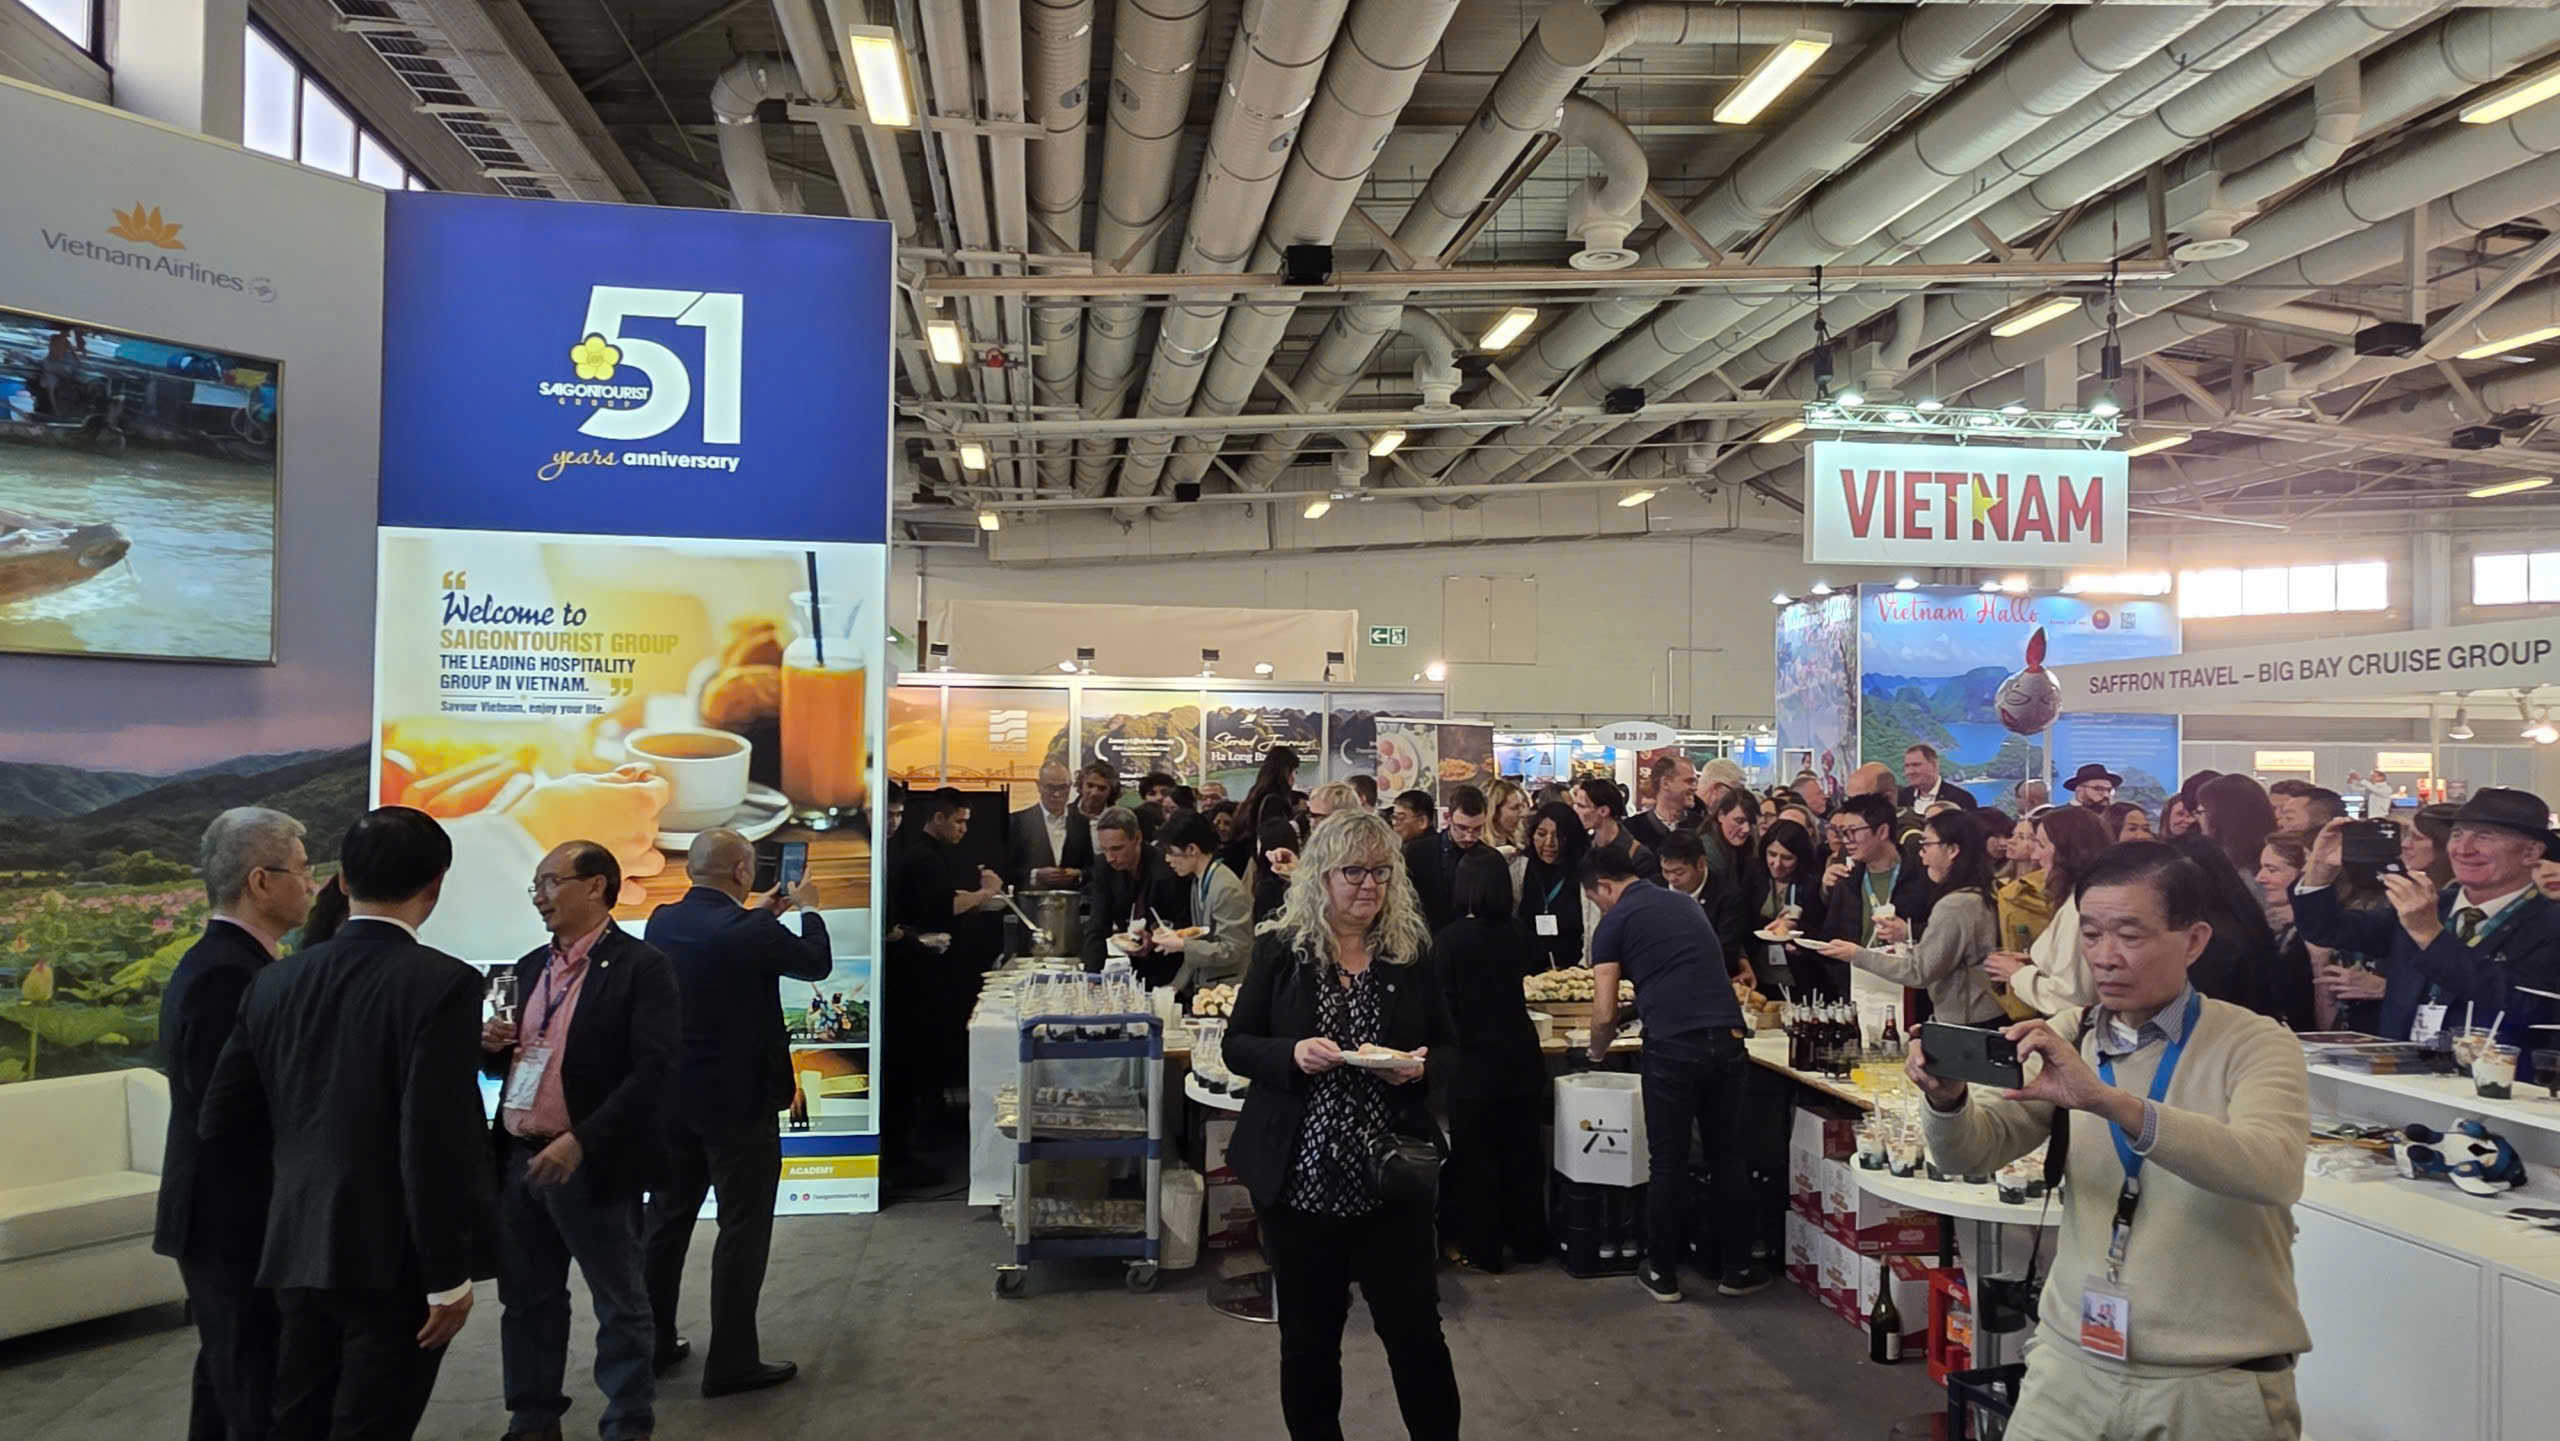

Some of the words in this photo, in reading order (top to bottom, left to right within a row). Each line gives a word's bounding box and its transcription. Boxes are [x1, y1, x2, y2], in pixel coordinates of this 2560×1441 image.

[41, 228, 151, 271] Vietnam
[153, 256, 243, 292] Airlines
[577, 285, 743, 444] 51
[539, 382, 650, 400] SAIGONTOURIST
[538, 449, 619, 481] years
[623, 451, 740, 472] anniversary
[1839, 468, 2103, 544] VIETNAM
[442, 591, 554, 626] Welcome
[563, 602, 587, 626] to
[1872, 592, 1968, 623] Vietnam
[1976, 593, 2039, 624] Hallo
[440, 629, 604, 653] SAIGONTOURIST
[611, 633, 679, 655] GROUP
[440, 654, 468, 669] THE
[471, 655, 536, 672] LEADING
[540, 656, 636, 673] HOSPITALITY
[2089, 671, 2165, 694] SAFFRON
[2169, 666, 2239, 689] TRAVEL
[2258, 661, 2294, 683] BIG
[2300, 656, 2342, 680] BAY
[2348, 648, 2441, 676] CRUISE
[2448, 639, 2552, 669] GROUP
[440, 674, 491, 690] GROUP
[496, 675, 511, 690] IN
[516, 676, 589, 692] VIETNAM.
[440, 701, 477, 713] Savour
[529, 702, 557, 715] enjoy
[560, 703, 583, 716] your
[586, 703, 605, 715] life.
[1211, 752, 1226, 761] Ha
[1228, 752, 1253, 764] Long
[789, 1166, 834, 1175] ACADEMY
